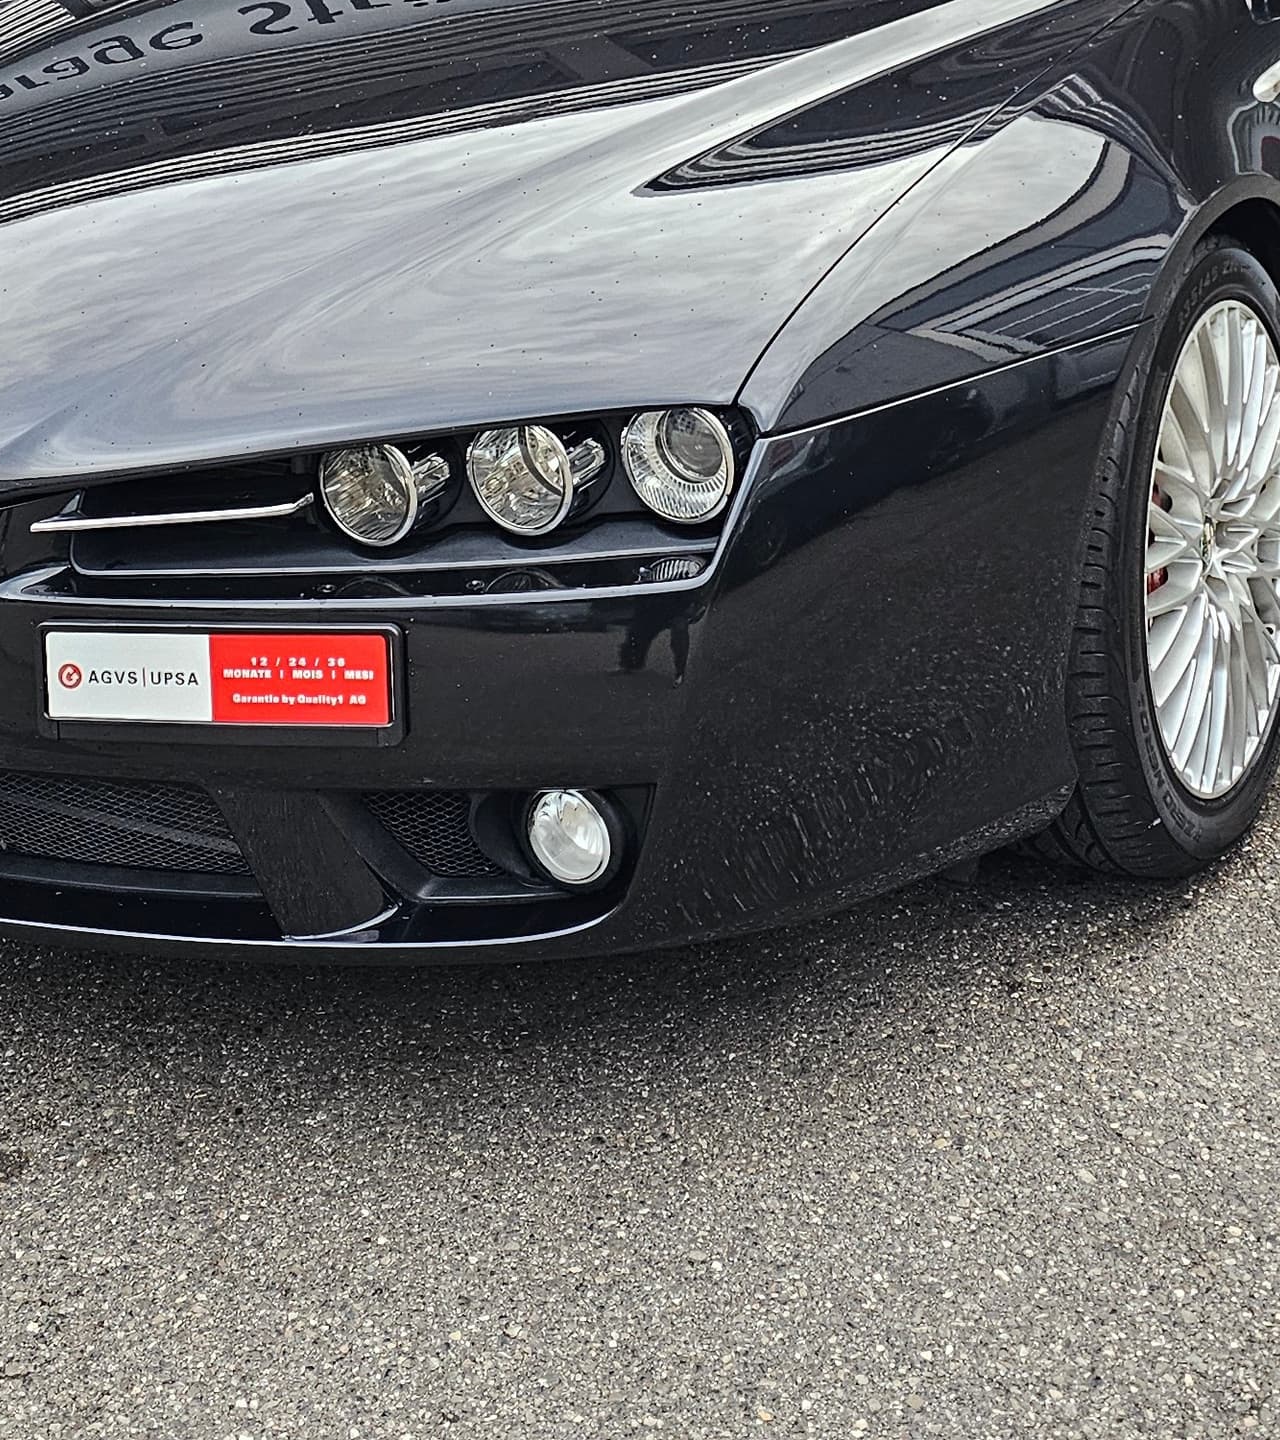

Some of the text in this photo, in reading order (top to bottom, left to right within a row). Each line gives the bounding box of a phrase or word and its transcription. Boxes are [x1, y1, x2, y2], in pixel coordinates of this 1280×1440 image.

[292, 669, 324, 680] MOIS
[281, 694, 296, 706] by
[349, 695, 367, 705] AG
